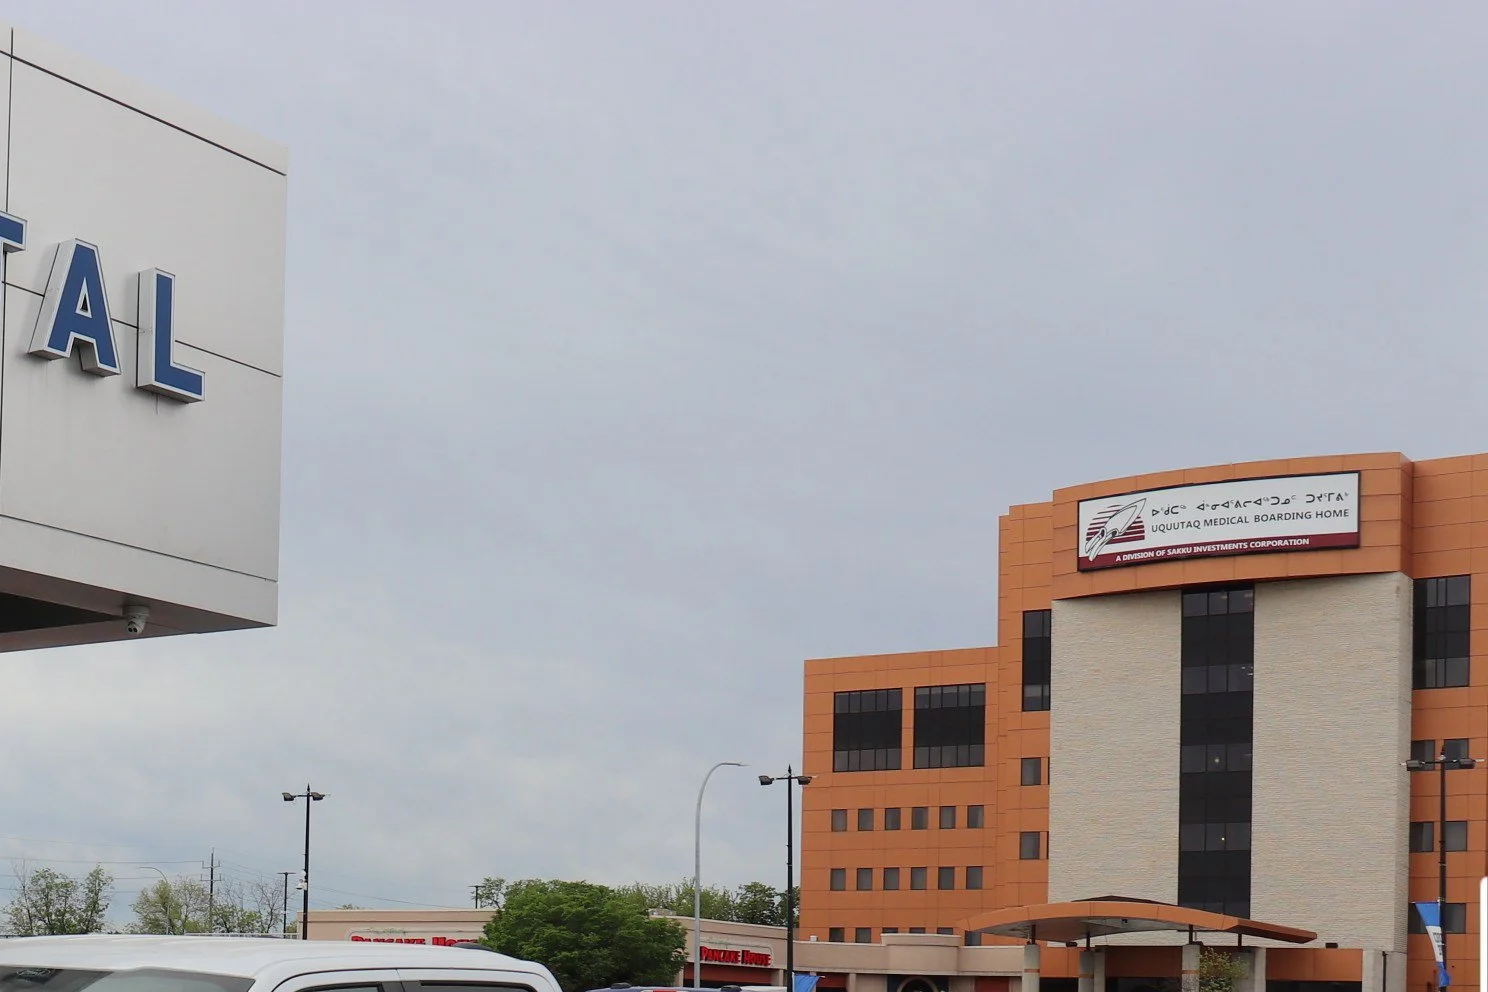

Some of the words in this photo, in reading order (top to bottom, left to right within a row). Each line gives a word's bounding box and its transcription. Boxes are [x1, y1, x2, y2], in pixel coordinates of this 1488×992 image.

[1151, 519, 1201, 534] UQUUTAQ
[1203, 515, 1250, 528] MEDICAL
[1254, 511, 1312, 523] BOARDING
[1315, 508, 1350, 519] HOME
[1122, 550, 1154, 561] DIVISION
[1155, 549, 1166, 557] OF
[1166, 546, 1192, 555] SAKKU
[1193, 542, 1248, 552] INVESTMENTS
[1249, 538, 1310, 548] CORPORATION
